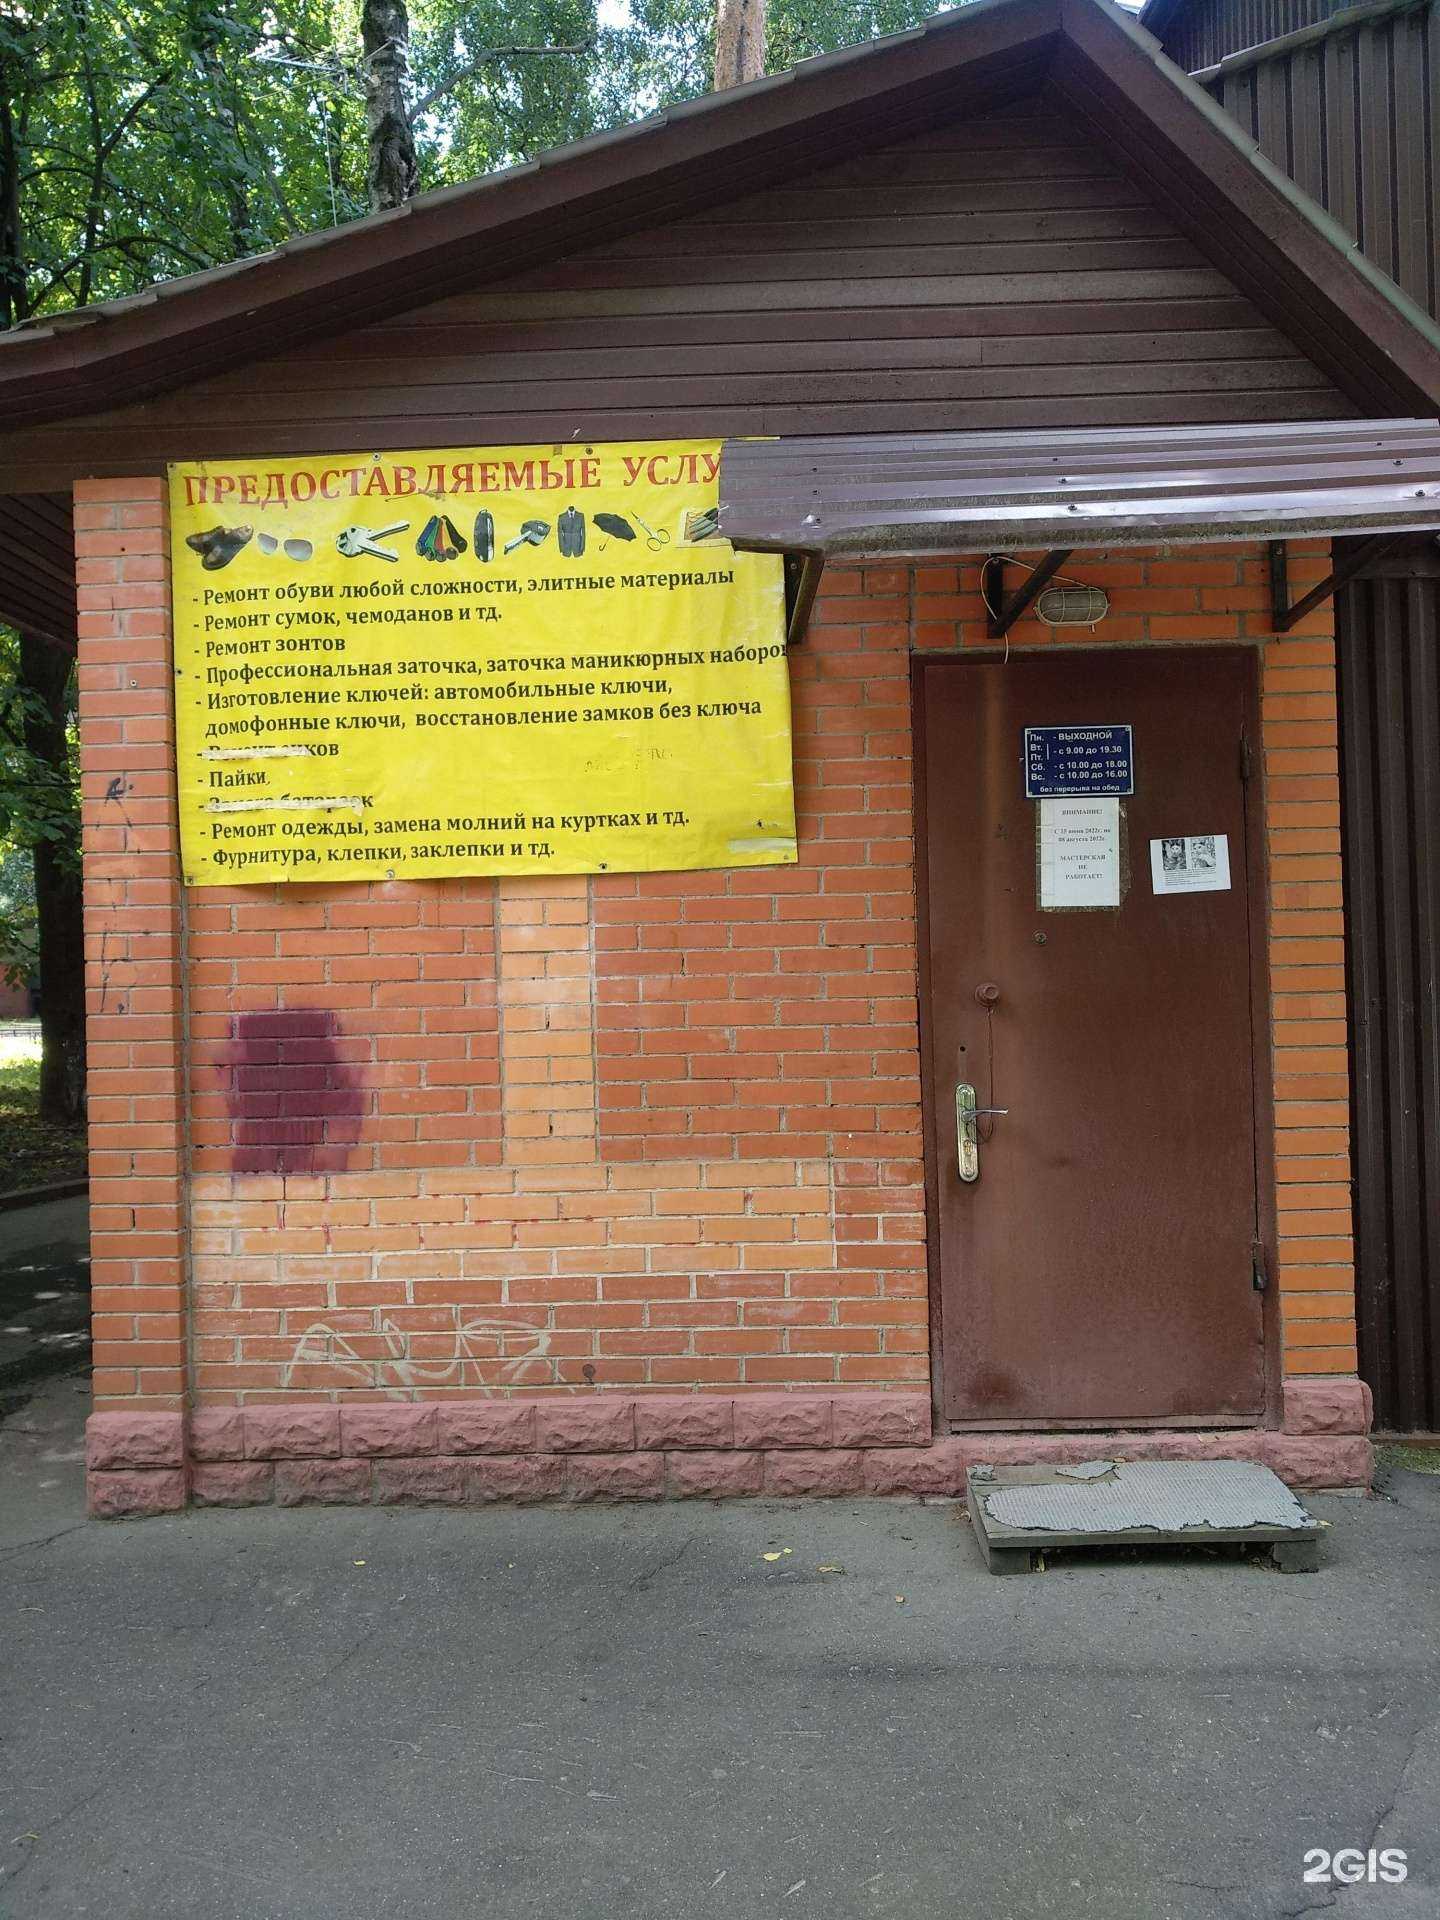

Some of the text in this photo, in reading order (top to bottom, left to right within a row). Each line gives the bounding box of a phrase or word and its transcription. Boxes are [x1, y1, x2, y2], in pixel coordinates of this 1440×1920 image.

[184, 453, 721, 510] ПРЕДОСТАВЛЯЕМЫЕ УСЛУ
[204, 587, 269, 606] Ремонт
[276, 582, 333, 602] обуви
[340, 578, 404, 598] любой
[411, 578, 522, 597] сложности,
[528, 574, 615, 591] элитные
[621, 570, 734, 589] материалы
[205, 612, 270, 631] Ремонт
[276, 610, 340, 629] сумок,
[346, 608, 453, 625] чемоданов
[459, 608, 471, 620] и
[206, 640, 270, 657] Ремонт
[276, 636, 345, 652] зонтов
[207, 661, 393, 687] Профессиональная
[398, 659, 482, 675] заточка,
[487, 656, 566, 673] заточка
[572, 651, 704, 673] маникюрных
[208, 688, 341, 710] Изготовление
[347, 685, 429, 704] ключей:
[434, 681, 595, 700] автомобильные
[601, 678, 672, 695] ключи,
[206, 700, 762, 738] домофонные ключи, восстановление замков без ключа
[1059, 730, 1112, 741] ВЫХОДНОЙ
[212, 821, 276, 840] Ремонт
[282, 817, 368, 837] одежды,
[374, 817, 441, 833] замена
[446, 813, 526, 831] молний
[532, 811, 555, 829] на
[561, 811, 640, 832] куртках
[646, 813, 657, 825] и
[213, 848, 321, 869] Фурнитура,
[327, 845, 406, 862] клепки,
[411, 842, 504, 859] заклепки
[511, 842, 522, 856] и
